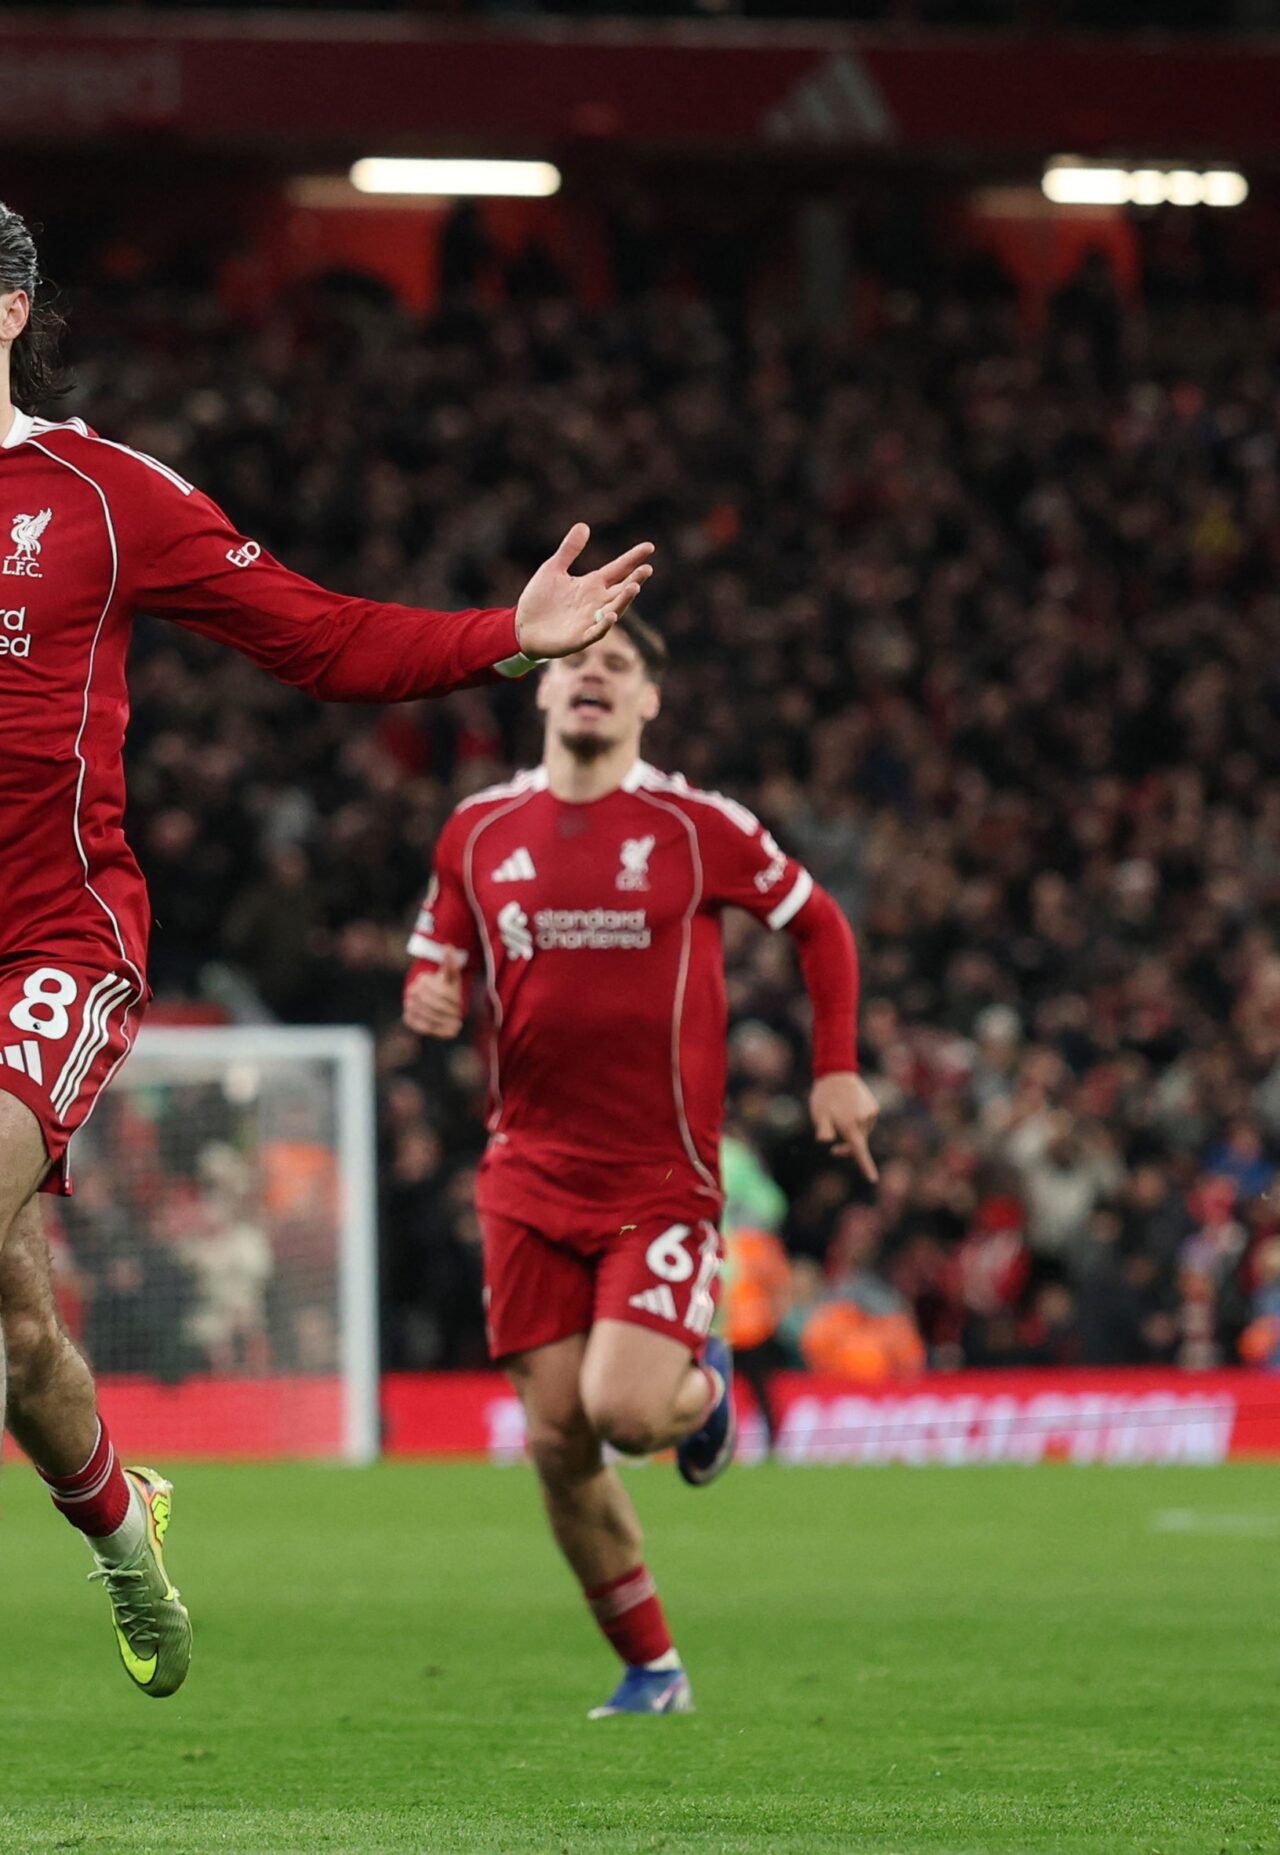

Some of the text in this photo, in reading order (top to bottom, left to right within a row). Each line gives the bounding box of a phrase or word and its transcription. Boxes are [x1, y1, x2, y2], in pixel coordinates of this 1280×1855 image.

[534, 907, 646, 931] standard
[9, 967, 78, 1040] 8
[645, 1222, 694, 1283] 6
